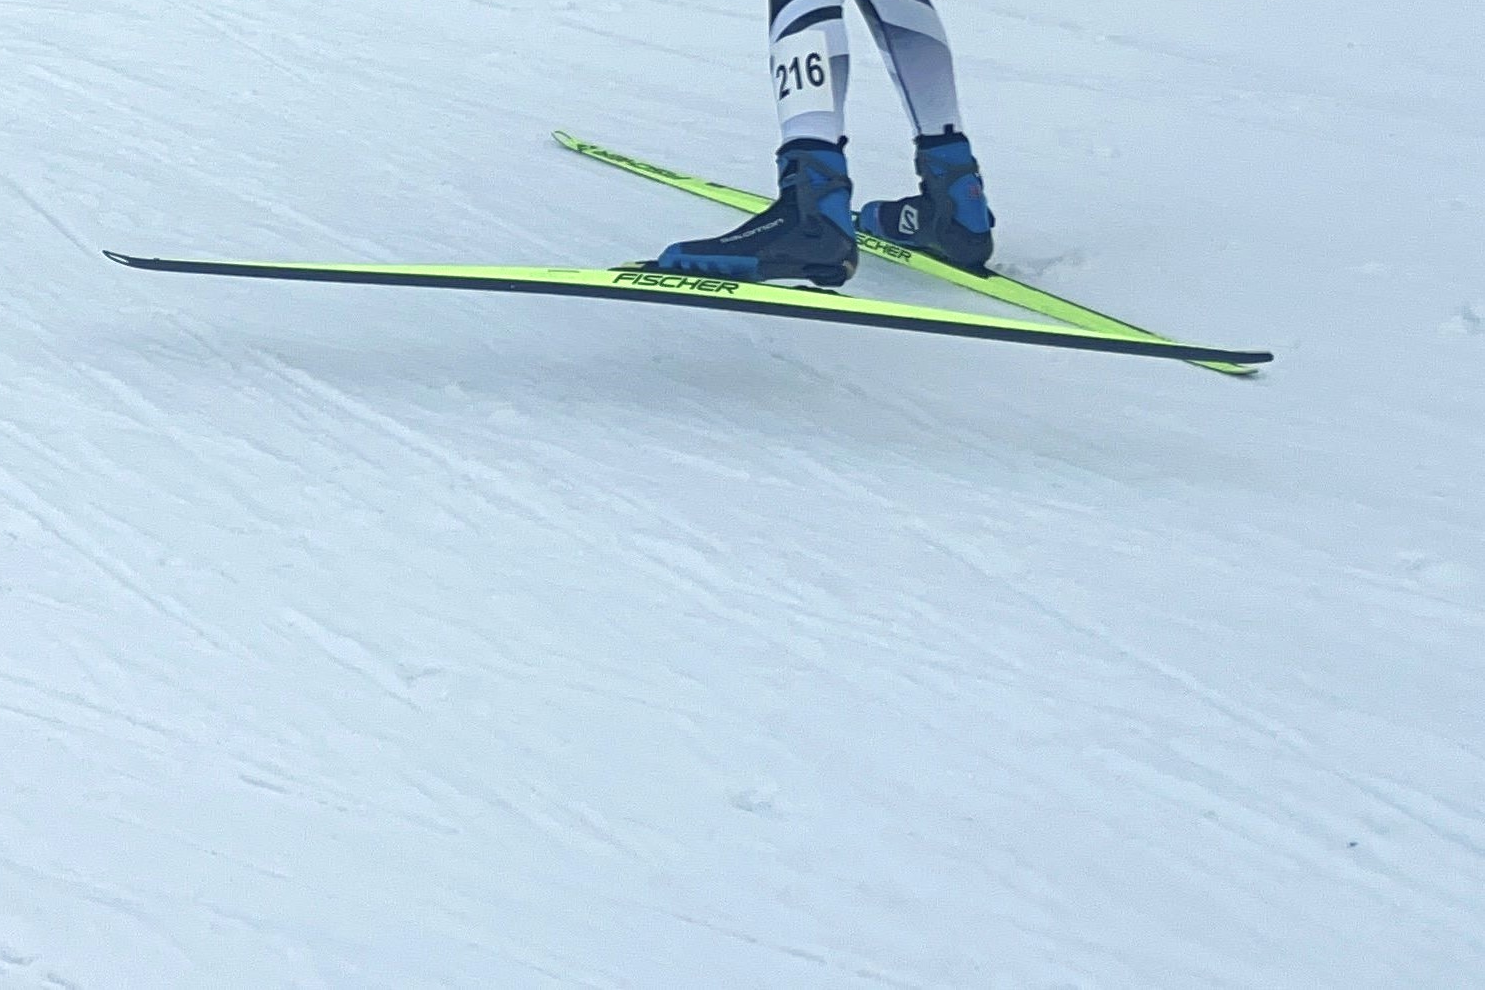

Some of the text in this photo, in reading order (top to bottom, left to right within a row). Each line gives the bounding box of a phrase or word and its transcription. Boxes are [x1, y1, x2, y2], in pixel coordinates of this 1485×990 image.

[775, 52, 826, 101] 216
[855, 233, 912, 262] SCHER
[612, 272, 740, 295] FISCHER
